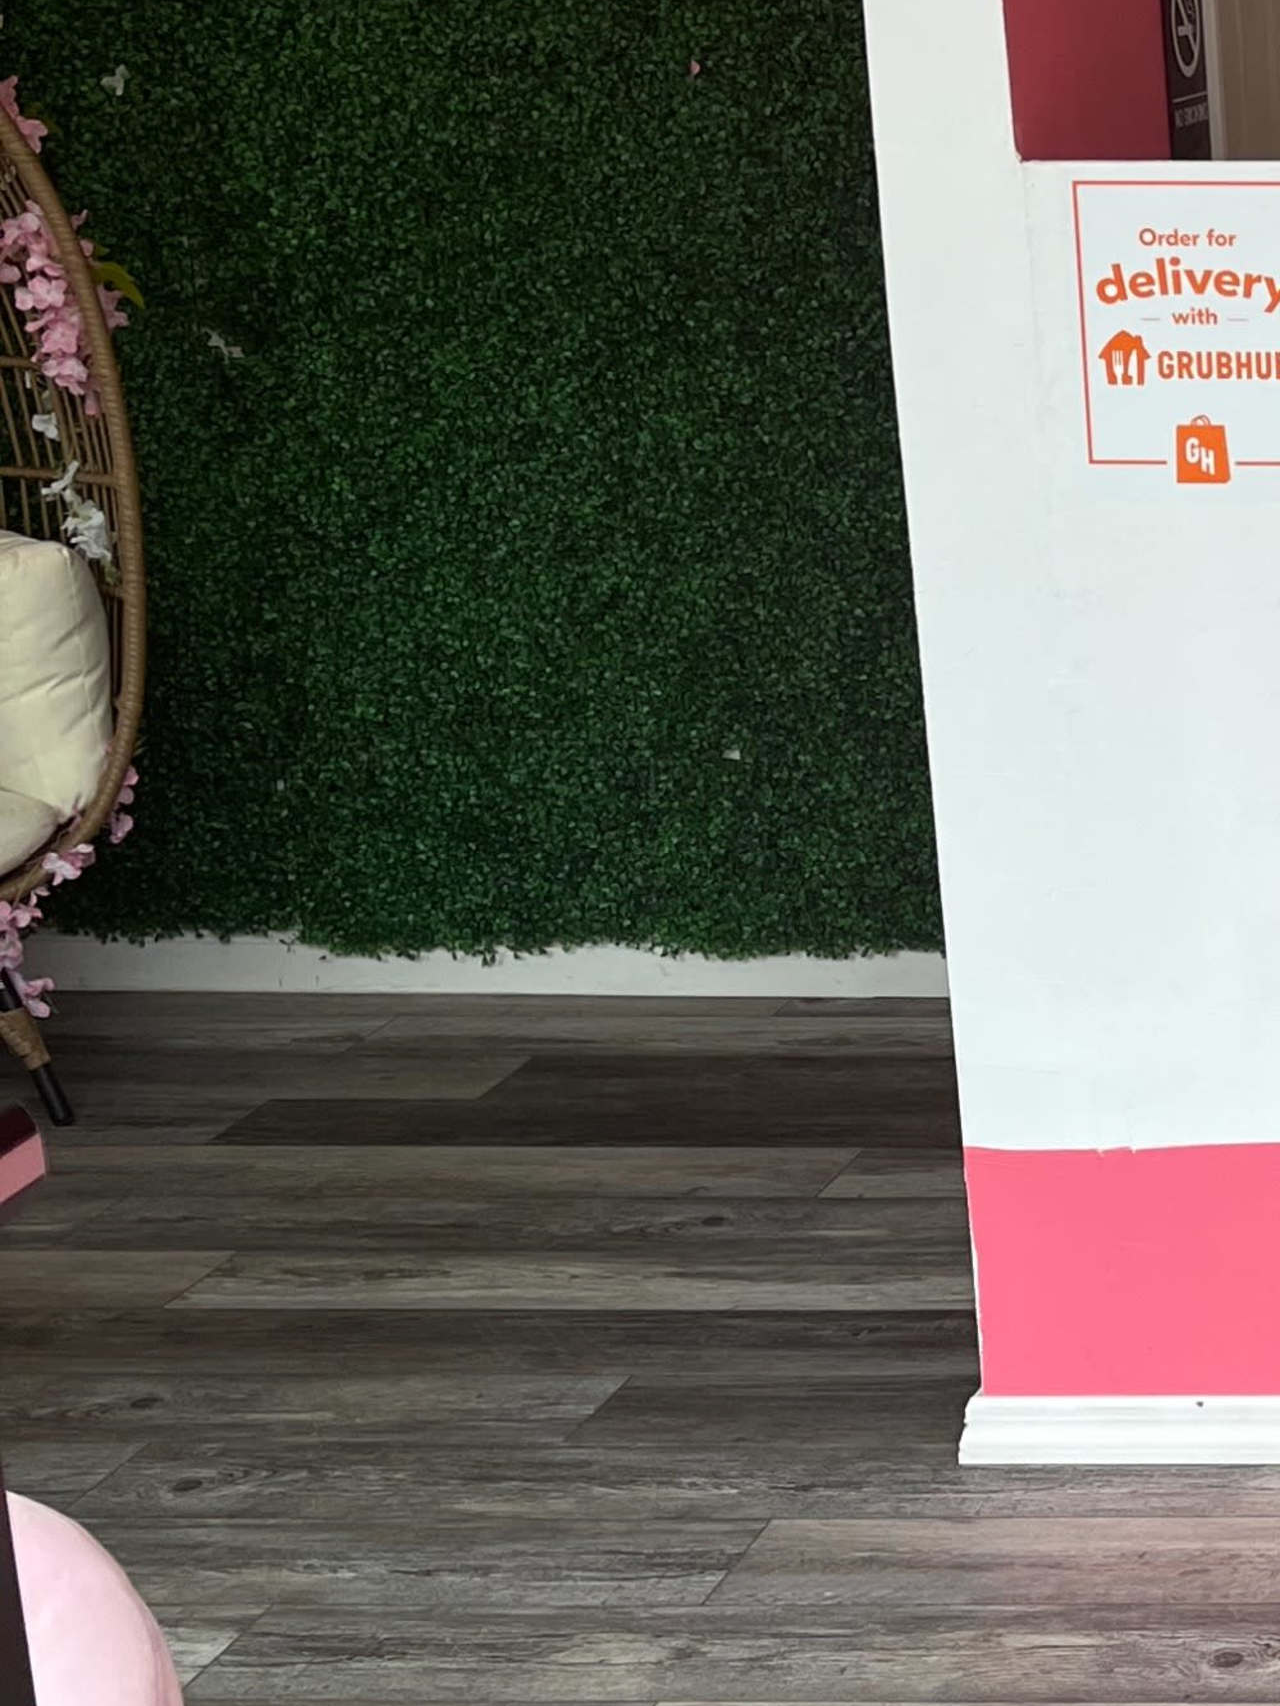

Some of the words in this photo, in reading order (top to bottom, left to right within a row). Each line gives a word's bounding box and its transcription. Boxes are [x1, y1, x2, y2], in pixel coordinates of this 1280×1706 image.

[1138, 227, 1200, 247] Order
[1206, 229, 1237, 246] for
[1172, 307, 1218, 325] with
